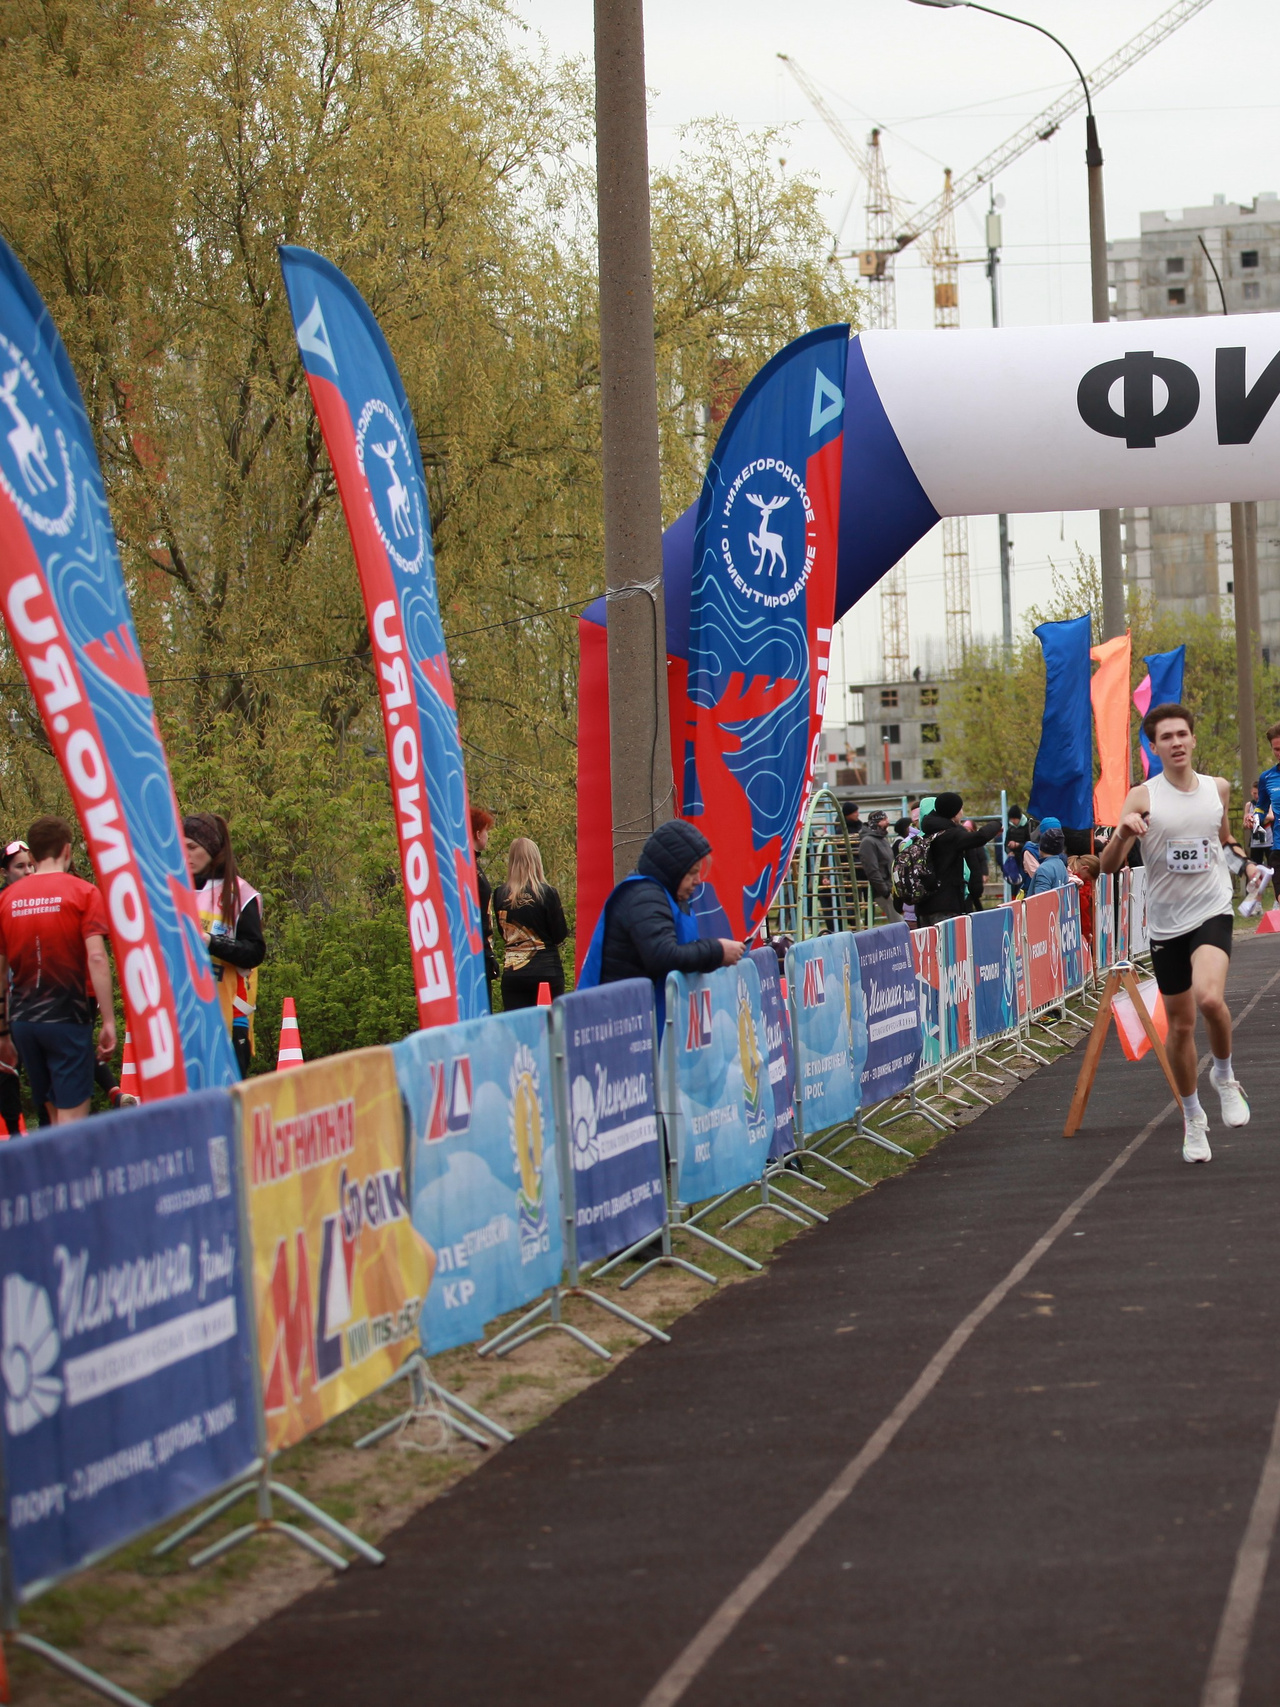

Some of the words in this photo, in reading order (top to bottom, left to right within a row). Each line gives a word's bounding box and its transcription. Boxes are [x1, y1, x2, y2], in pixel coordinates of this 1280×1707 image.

[723, 457, 815, 521] НИЖЕГОРОДСКОЕ
[721, 537, 816, 608] ОРИЕНТИРОВАНИЕ
[1172, 850, 1198, 860] 362
